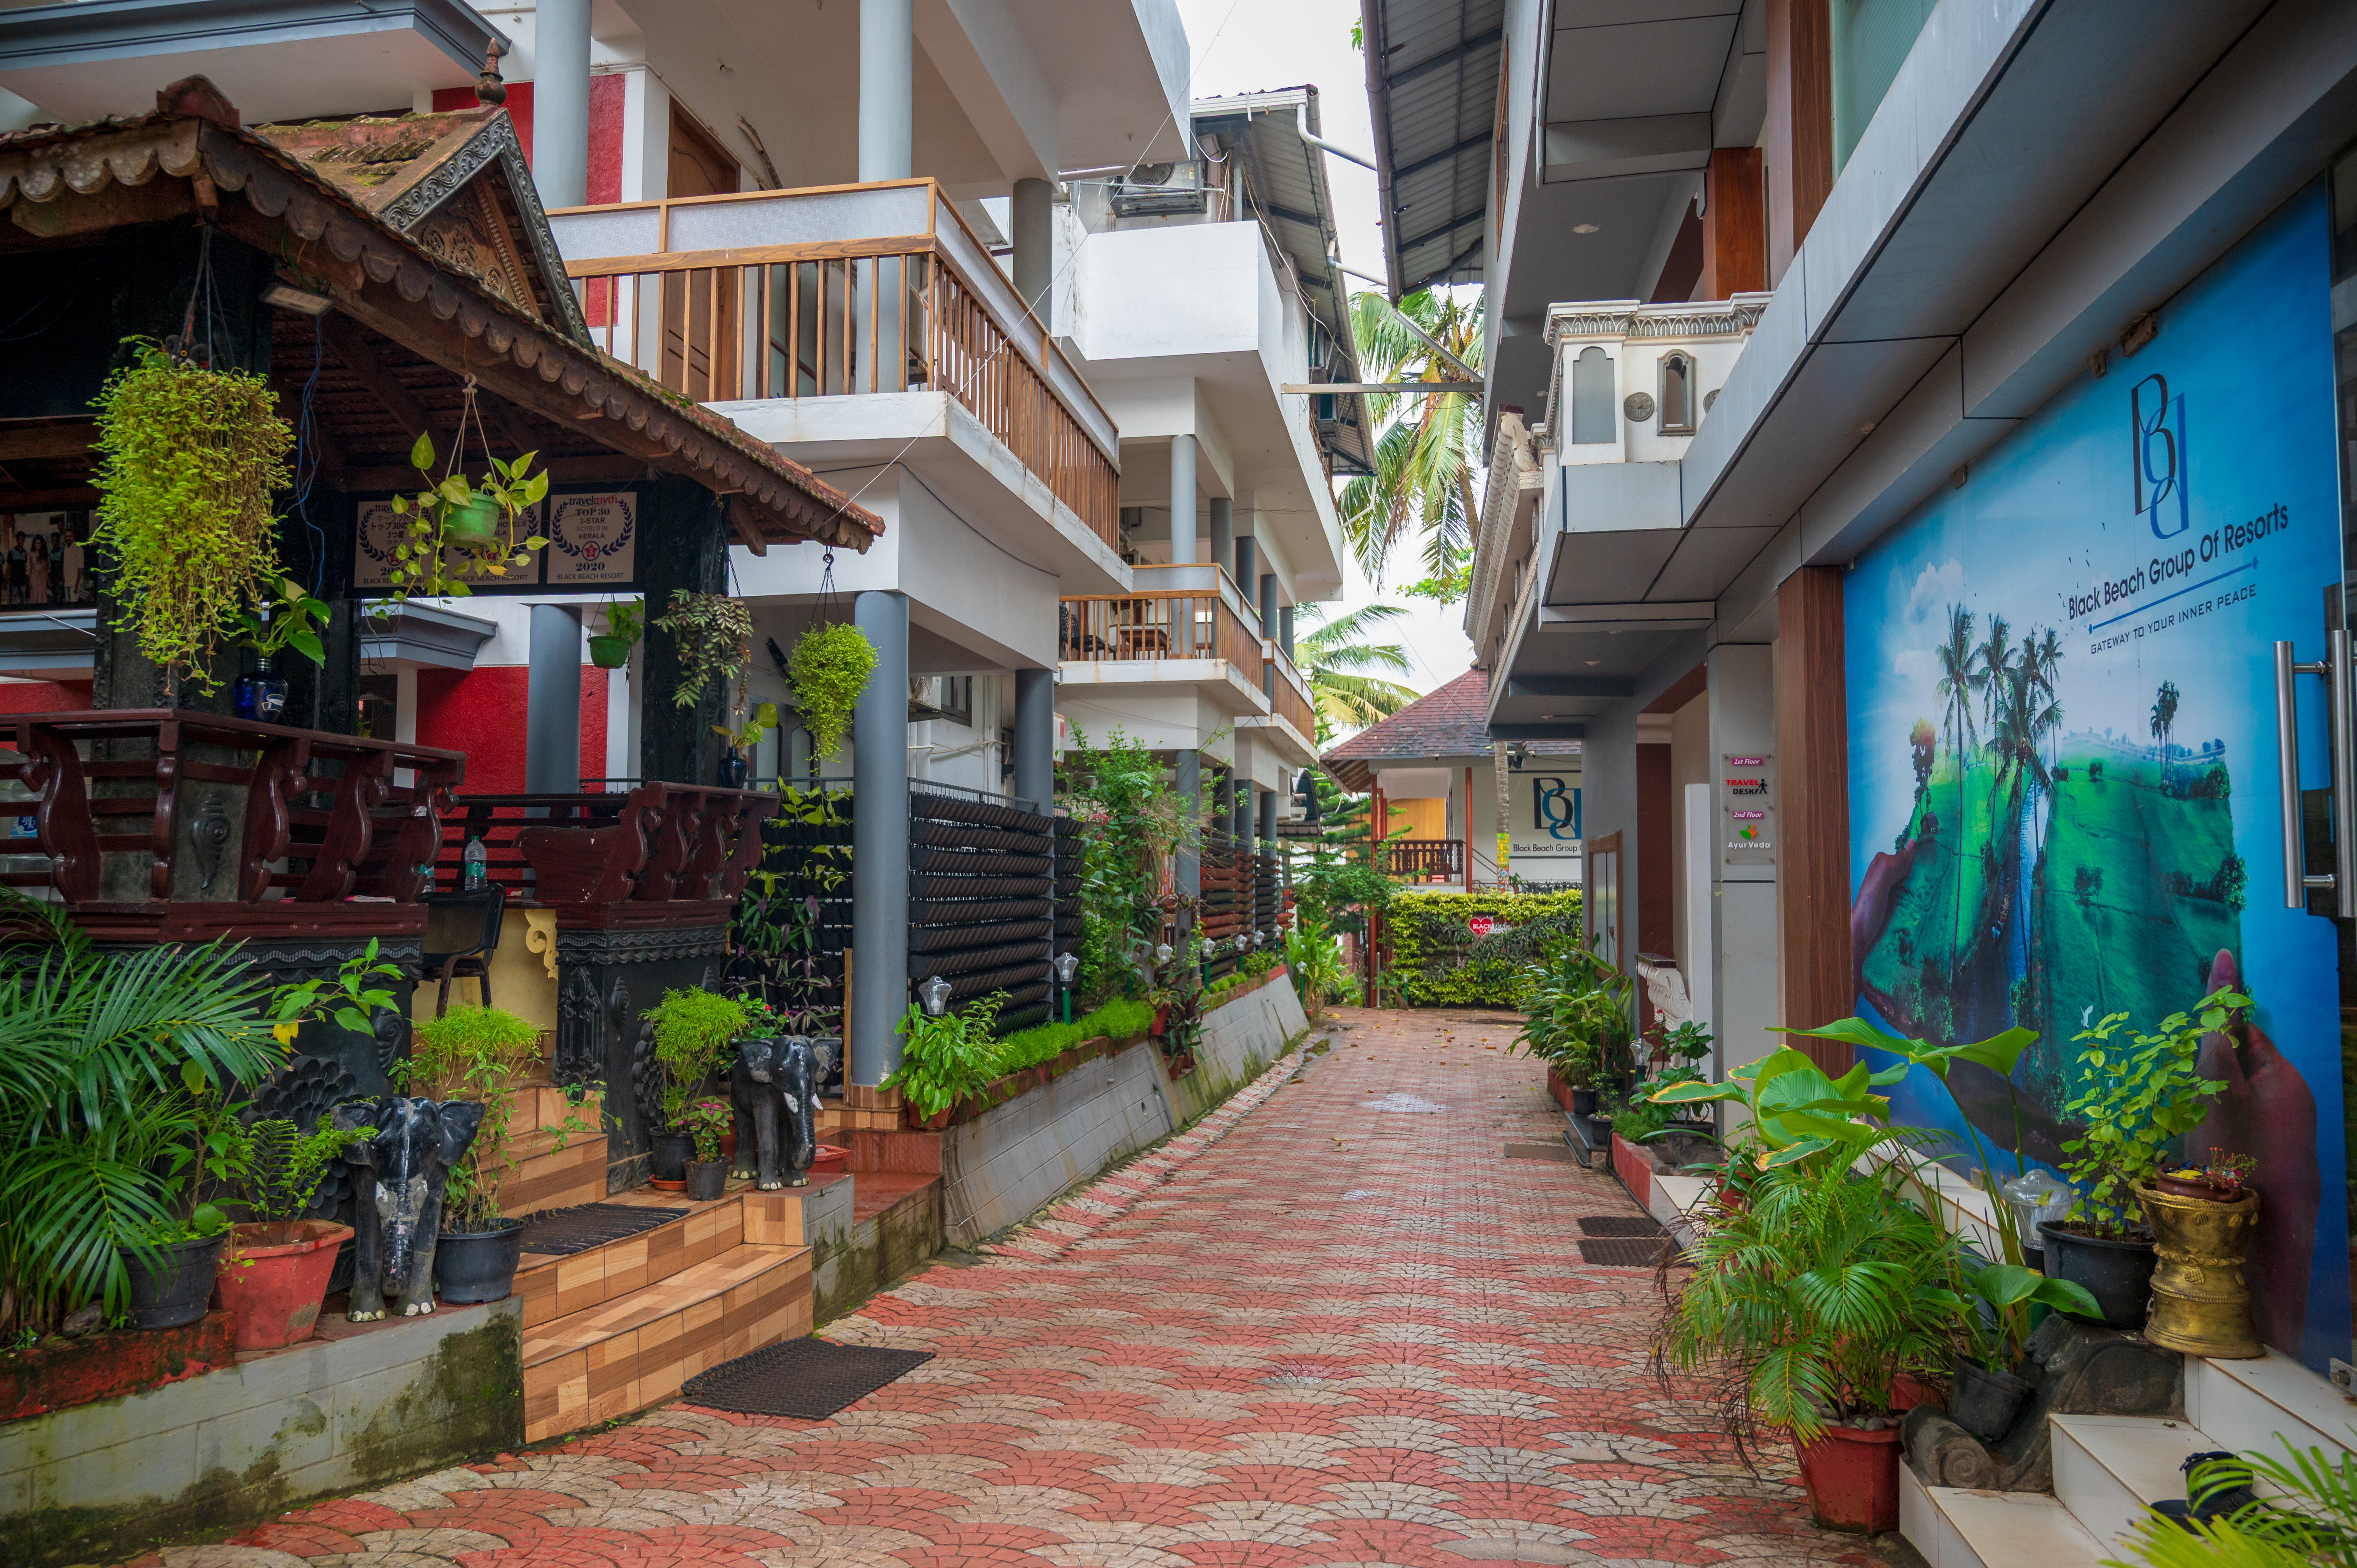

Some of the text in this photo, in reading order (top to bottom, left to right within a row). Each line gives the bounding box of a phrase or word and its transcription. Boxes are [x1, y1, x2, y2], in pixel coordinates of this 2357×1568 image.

[569, 495, 617, 508] travelmyth
[576, 508, 596, 516] TOP
[576, 562, 605, 571] 2020
[2069, 502, 2289, 620] Black Beach Group Of Resorts
[2091, 584, 2256, 654] GATEWAY TO YOUR INNER PEACE
[1513, 844, 1531, 852] Black
[1555, 844, 1578, 853] Group
